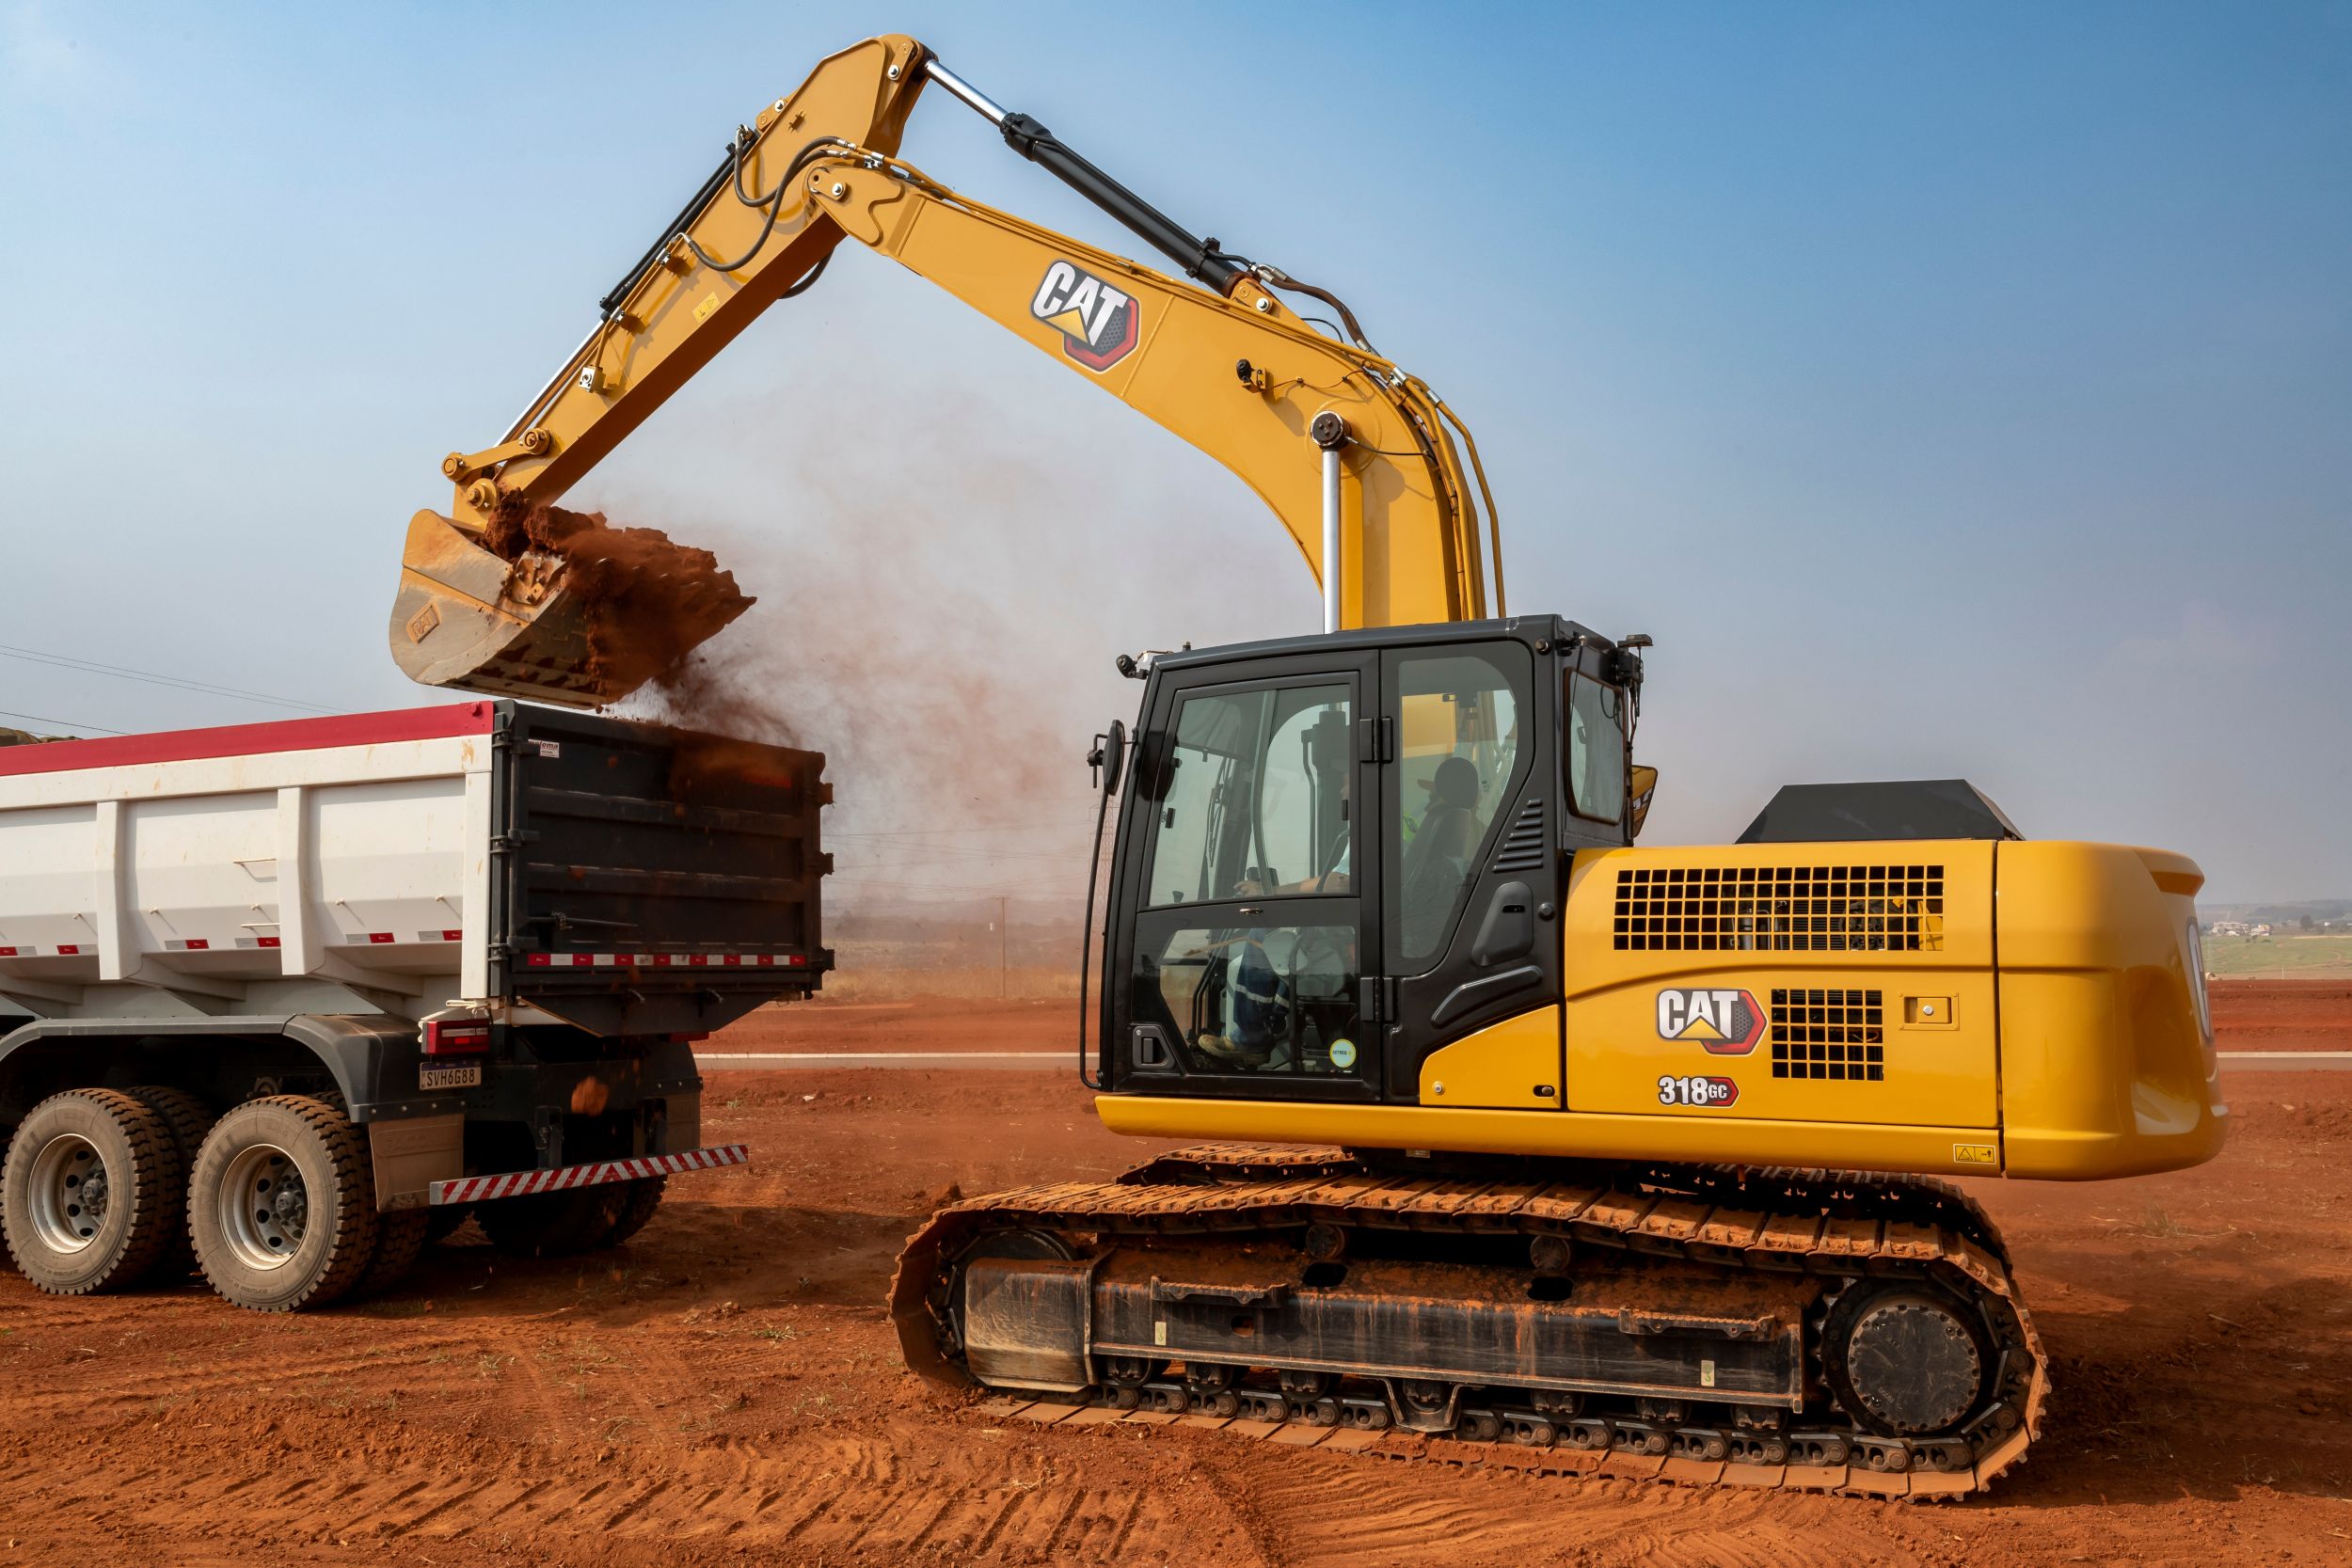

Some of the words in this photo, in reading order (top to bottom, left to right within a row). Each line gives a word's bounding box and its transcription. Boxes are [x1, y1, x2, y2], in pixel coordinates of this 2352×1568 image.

[1033, 261, 1128, 347] CAT
[1658, 990, 1739, 1039] CAT
[426, 1069, 475, 1086] SVH6G88
